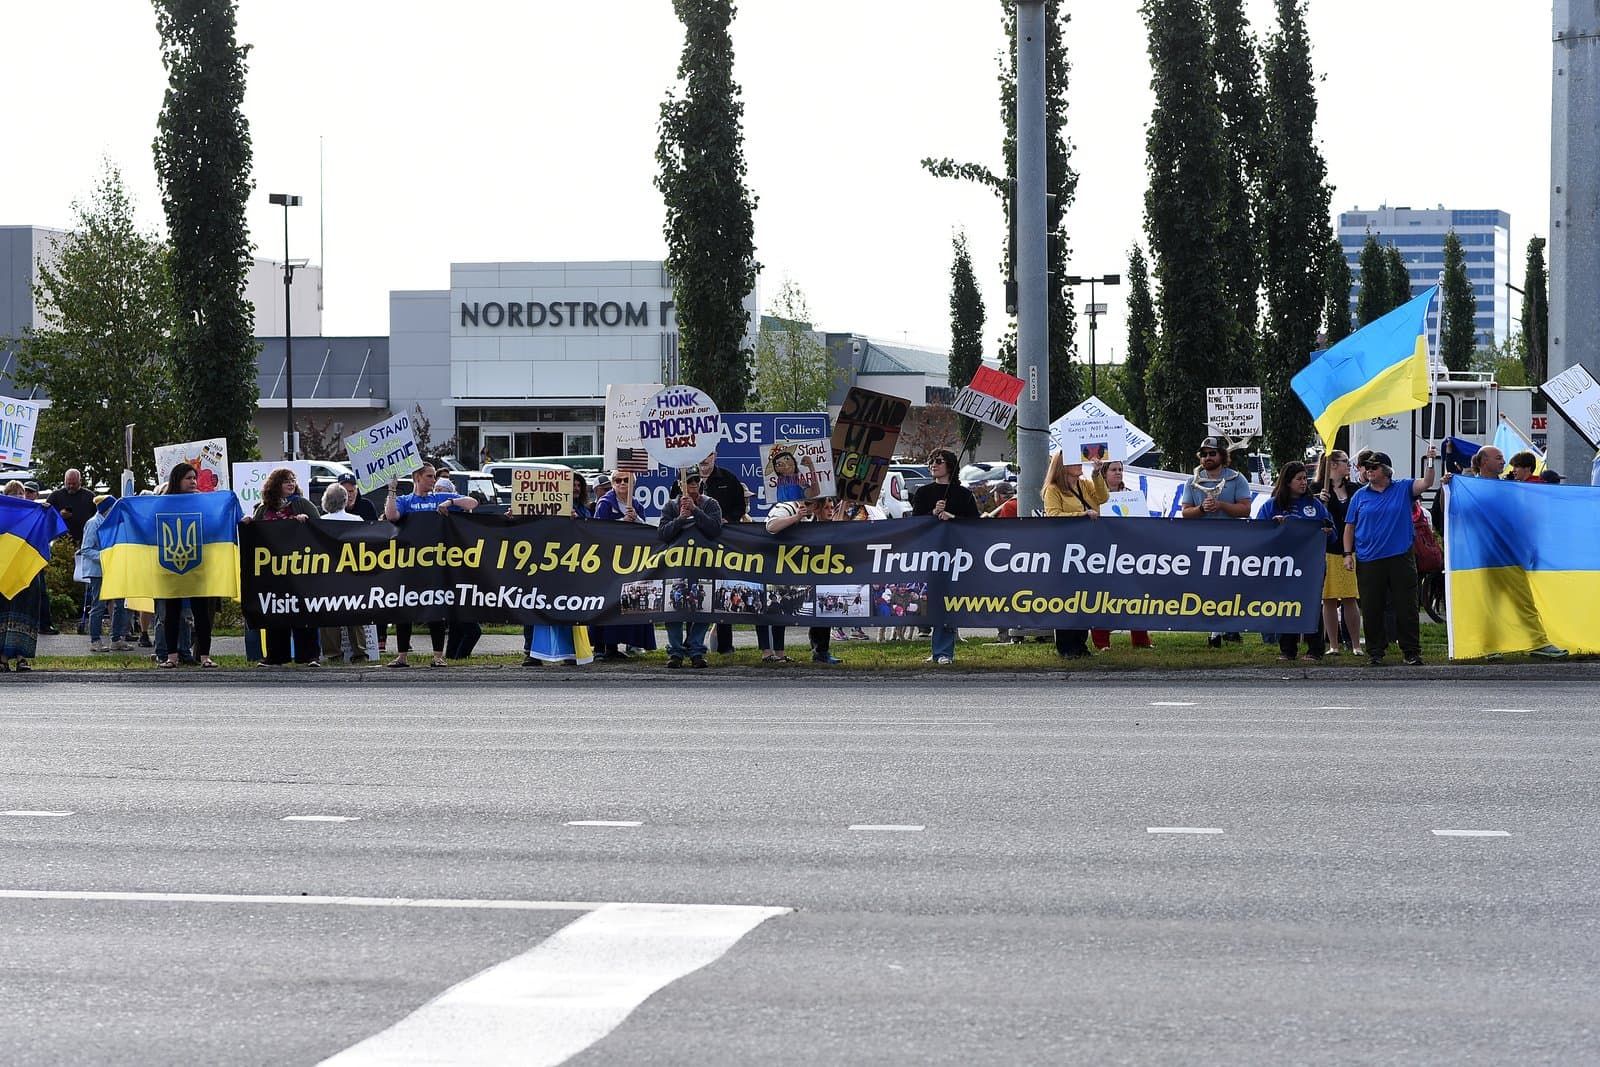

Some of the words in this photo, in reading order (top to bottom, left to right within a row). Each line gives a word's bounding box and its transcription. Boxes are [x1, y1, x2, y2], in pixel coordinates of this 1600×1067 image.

[461, 301, 649, 327] NORDSTROM
[1546, 367, 1593, 405] END
[657, 392, 699, 409] HONK
[953, 390, 1013, 426] MELANIA
[648, 408, 657, 417] if
[659, 409, 675, 419] you
[678, 406, 695, 415] want
[697, 406, 710, 414] our
[369, 417, 409, 444] STAND
[640, 415, 720, 439] DEMOCRACY
[720, 422, 762, 443] ASE
[780, 423, 821, 435] Colliers
[666, 435, 696, 449] BACK!
[845, 421, 886, 456] UP
[797, 440, 826, 457] Stand
[816, 454, 826, 463] in
[251, 469, 266, 483] So
[514, 470, 531, 480] GO
[538, 470, 571, 480] HOME
[741, 463, 763, 477] Me
[241, 488, 261, 501] UK
[520, 481, 559, 492] PUTIN
[515, 493, 534, 502] GET
[543, 493, 570, 502] LOST
[635, 486, 671, 510] 90
[519, 503, 562, 515] TRUMP
[254, 546, 330, 576] Putin
[335, 539, 485, 573] Abducted
[497, 540, 601, 576] 19,546
[612, 539, 764, 575] Ukrainian
[776, 545, 853, 575] Kids.
[867, 543, 973, 581] Trump
[984, 543, 1051, 573] Can
[1062, 543, 1191, 575] Release
[1197, 545, 1303, 577] Them.
[258, 592, 299, 614] Visit
[304, 584, 605, 612] www.ReleaseTheKids.com
[944, 590, 1302, 617] www.GoodUkraineDeal.com
